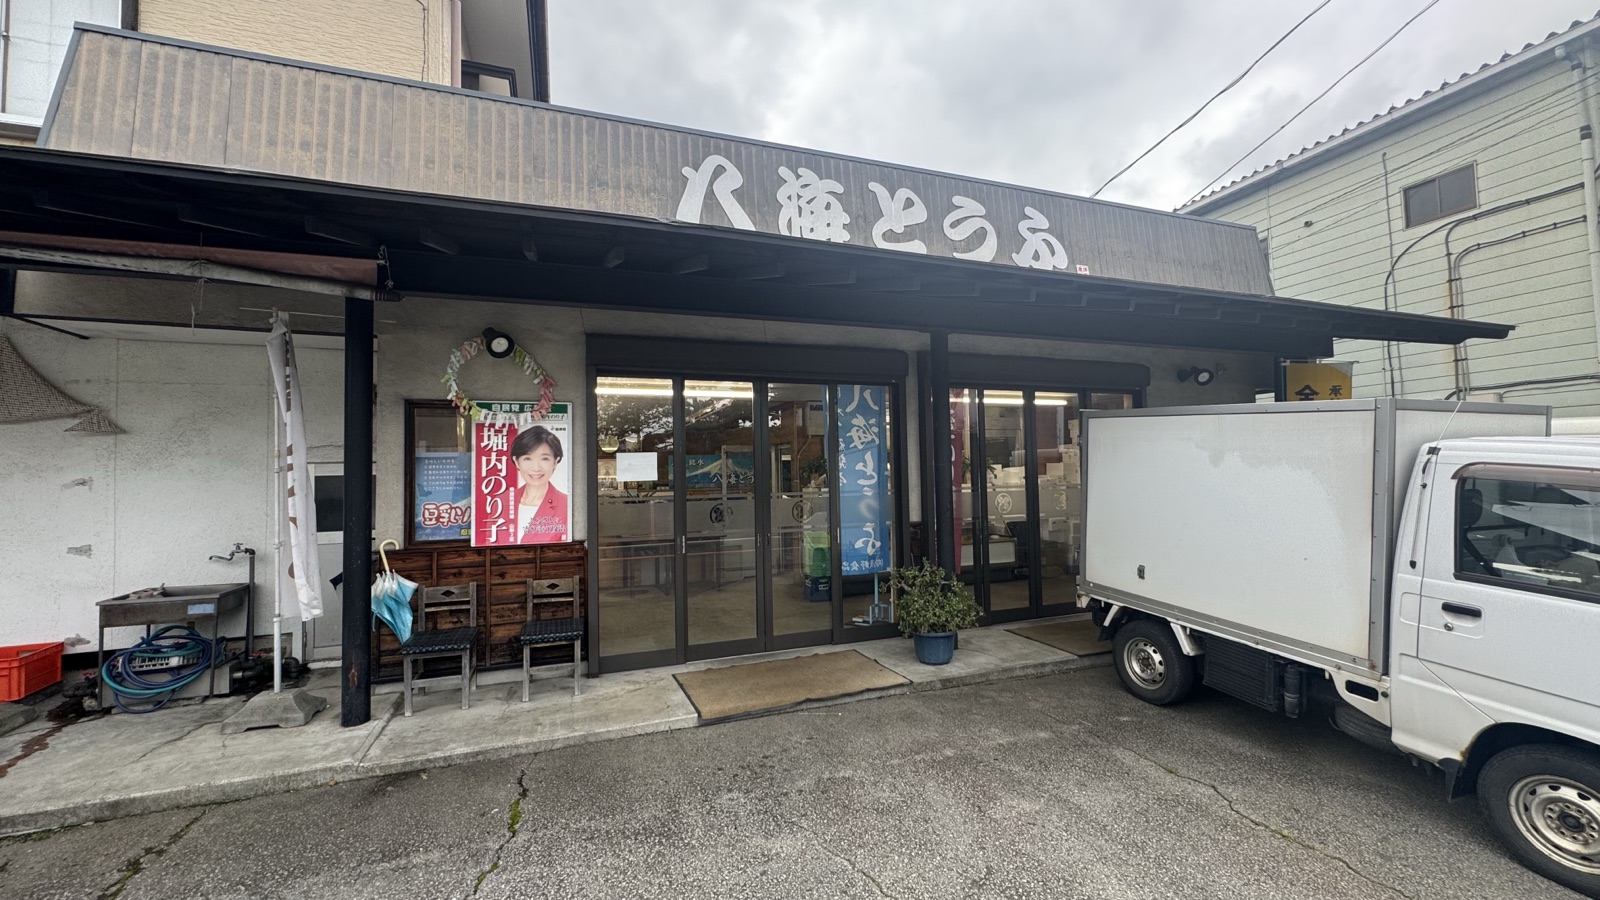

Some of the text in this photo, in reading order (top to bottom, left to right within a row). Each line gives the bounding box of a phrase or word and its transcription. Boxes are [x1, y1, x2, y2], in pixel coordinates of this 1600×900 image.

[676, 155, 1068, 270] 八海とうふ
[491, 403, 520, 412] 自民党
[480, 424, 508, 543] 堀内のり子
